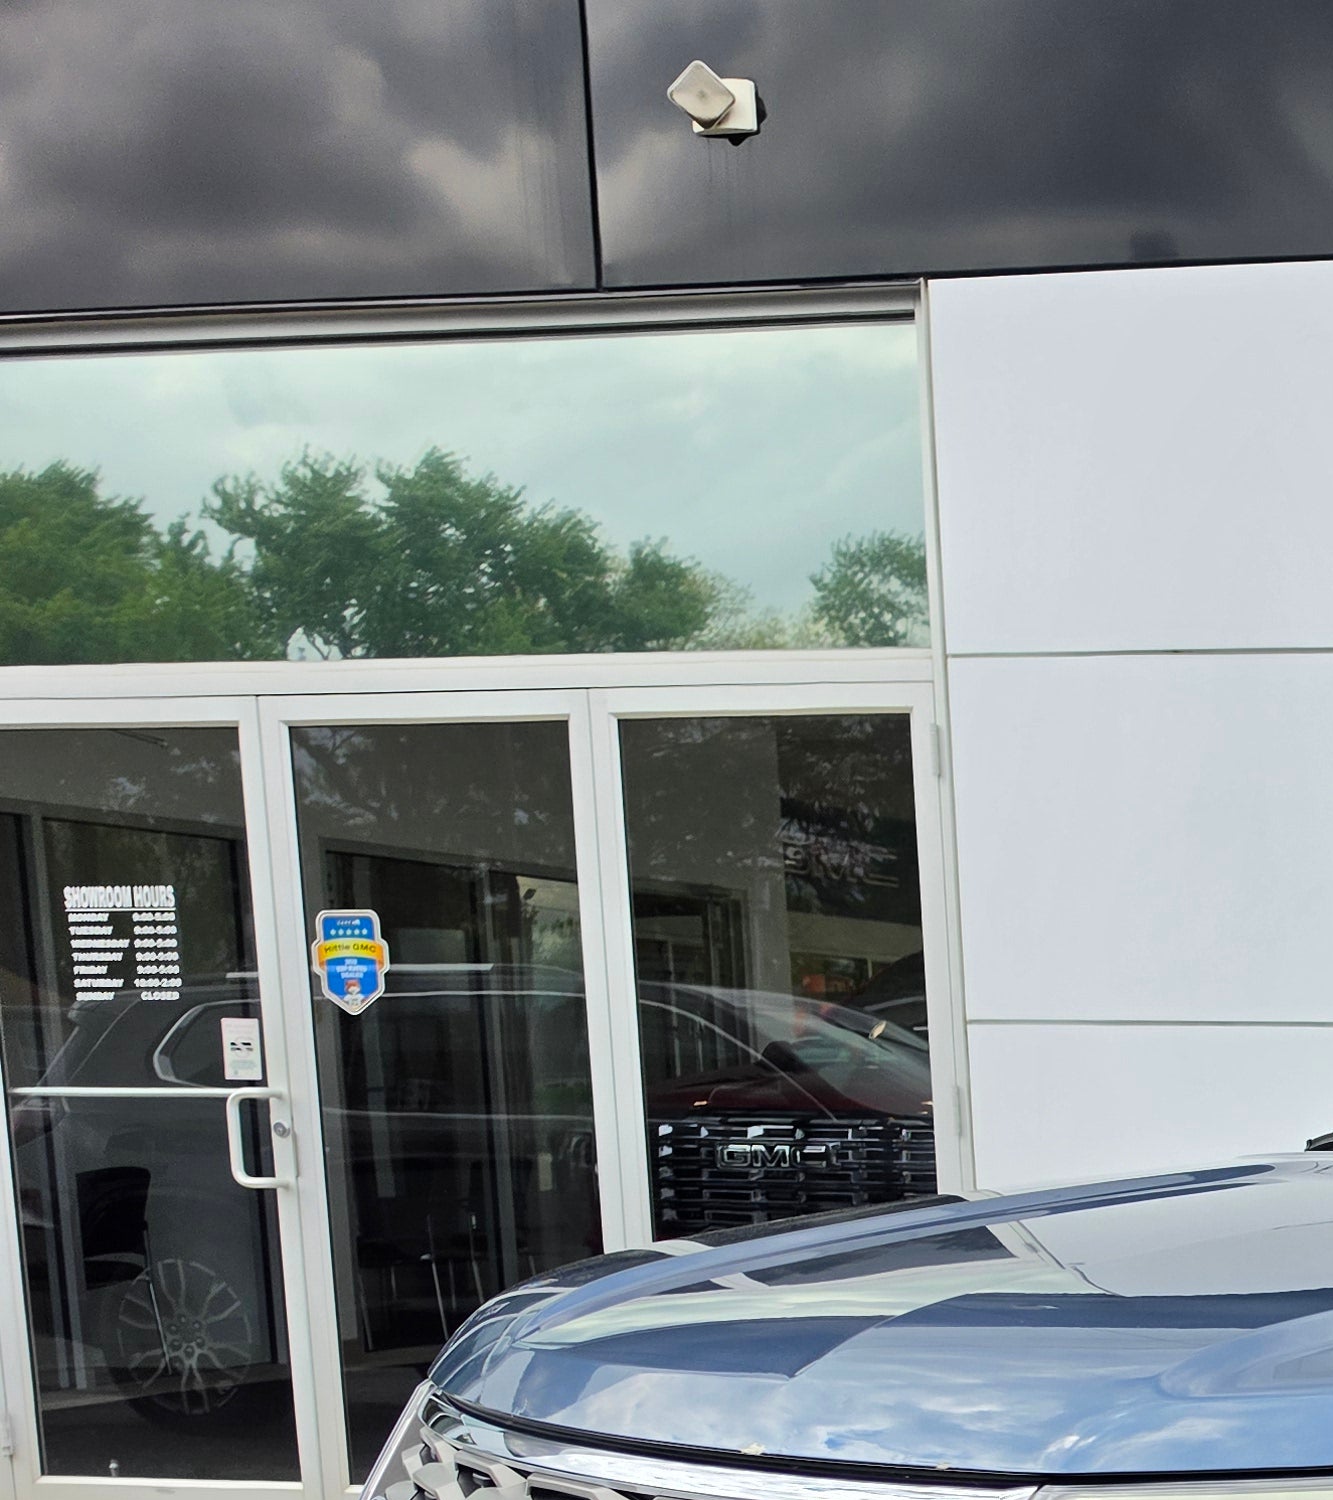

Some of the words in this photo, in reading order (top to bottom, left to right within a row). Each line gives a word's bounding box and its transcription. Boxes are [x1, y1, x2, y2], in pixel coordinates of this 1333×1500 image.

[63, 885, 132, 908] SHOWROOM
[132, 885, 175, 908] HOURS
[717, 1143, 832, 1170] GMC
